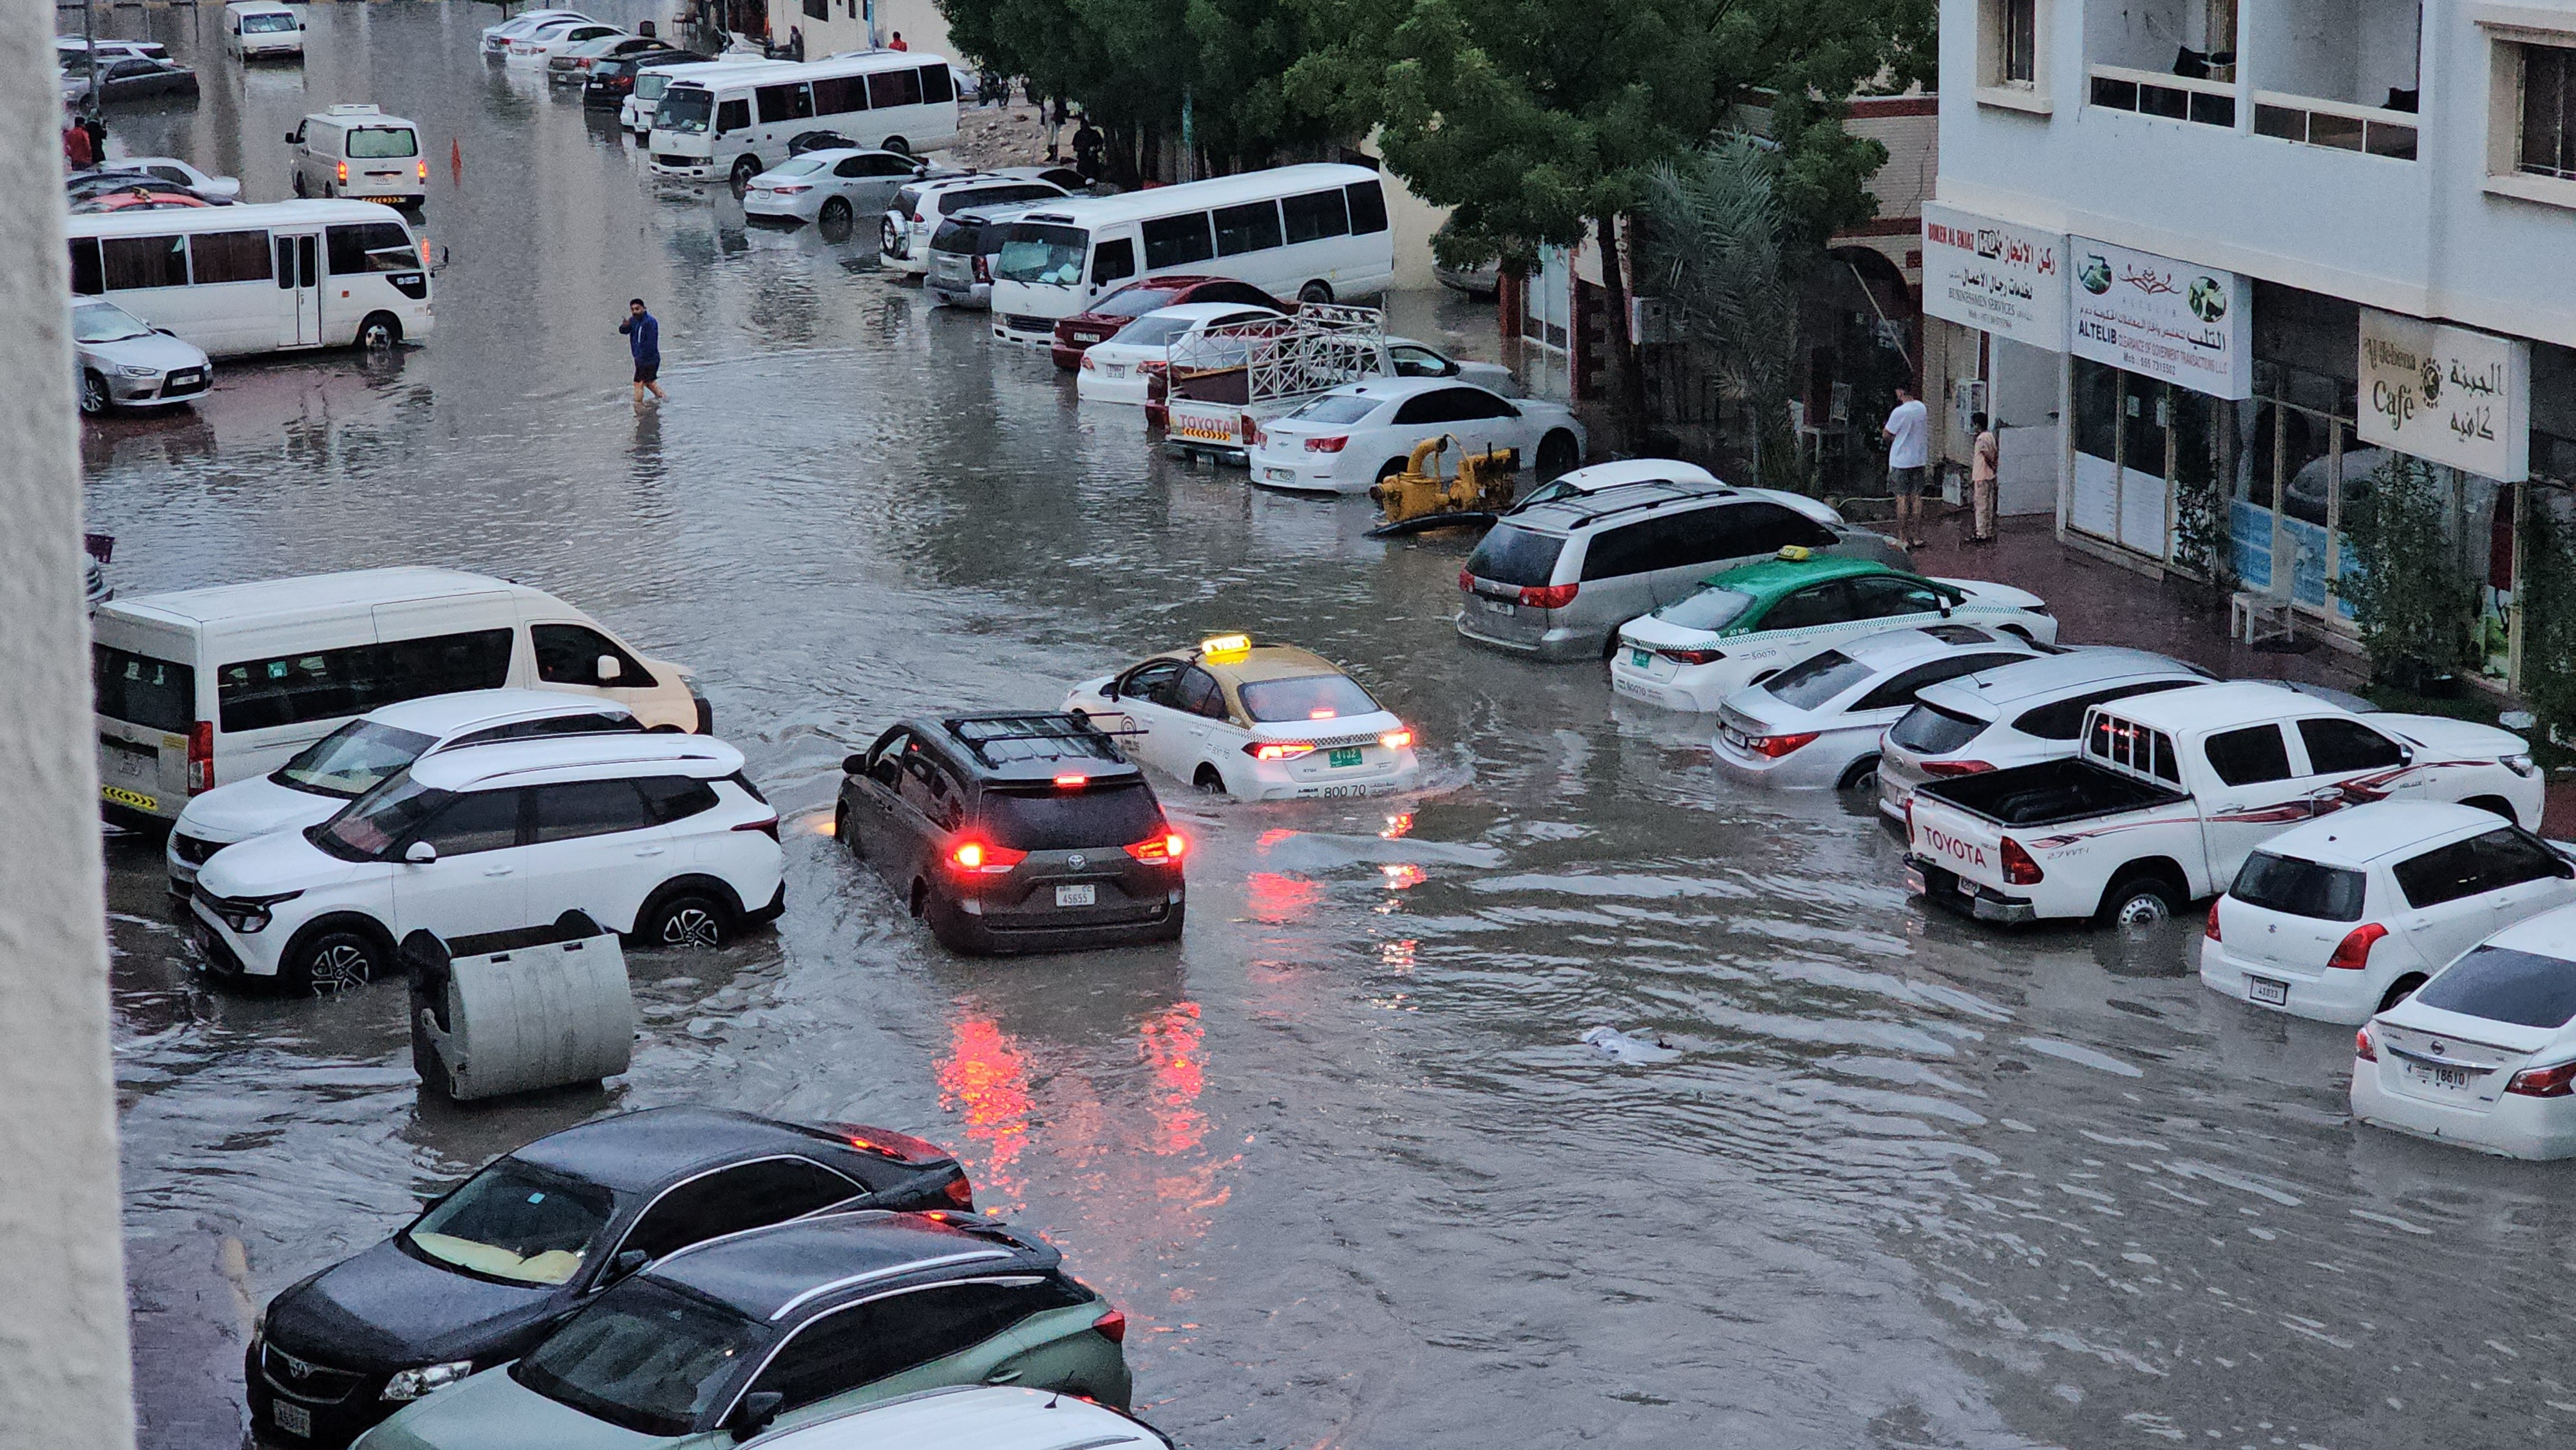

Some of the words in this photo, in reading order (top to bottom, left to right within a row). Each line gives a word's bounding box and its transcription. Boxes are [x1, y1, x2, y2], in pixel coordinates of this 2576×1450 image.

[2038, 247, 2055, 276] ركن
[2078, 319, 2117, 344] ALTELIB
[1180, 415, 1231, 434] TOYOTA
[1923, 825, 1987, 869] TOYOTA
[1063, 894, 1087, 904] 45655
